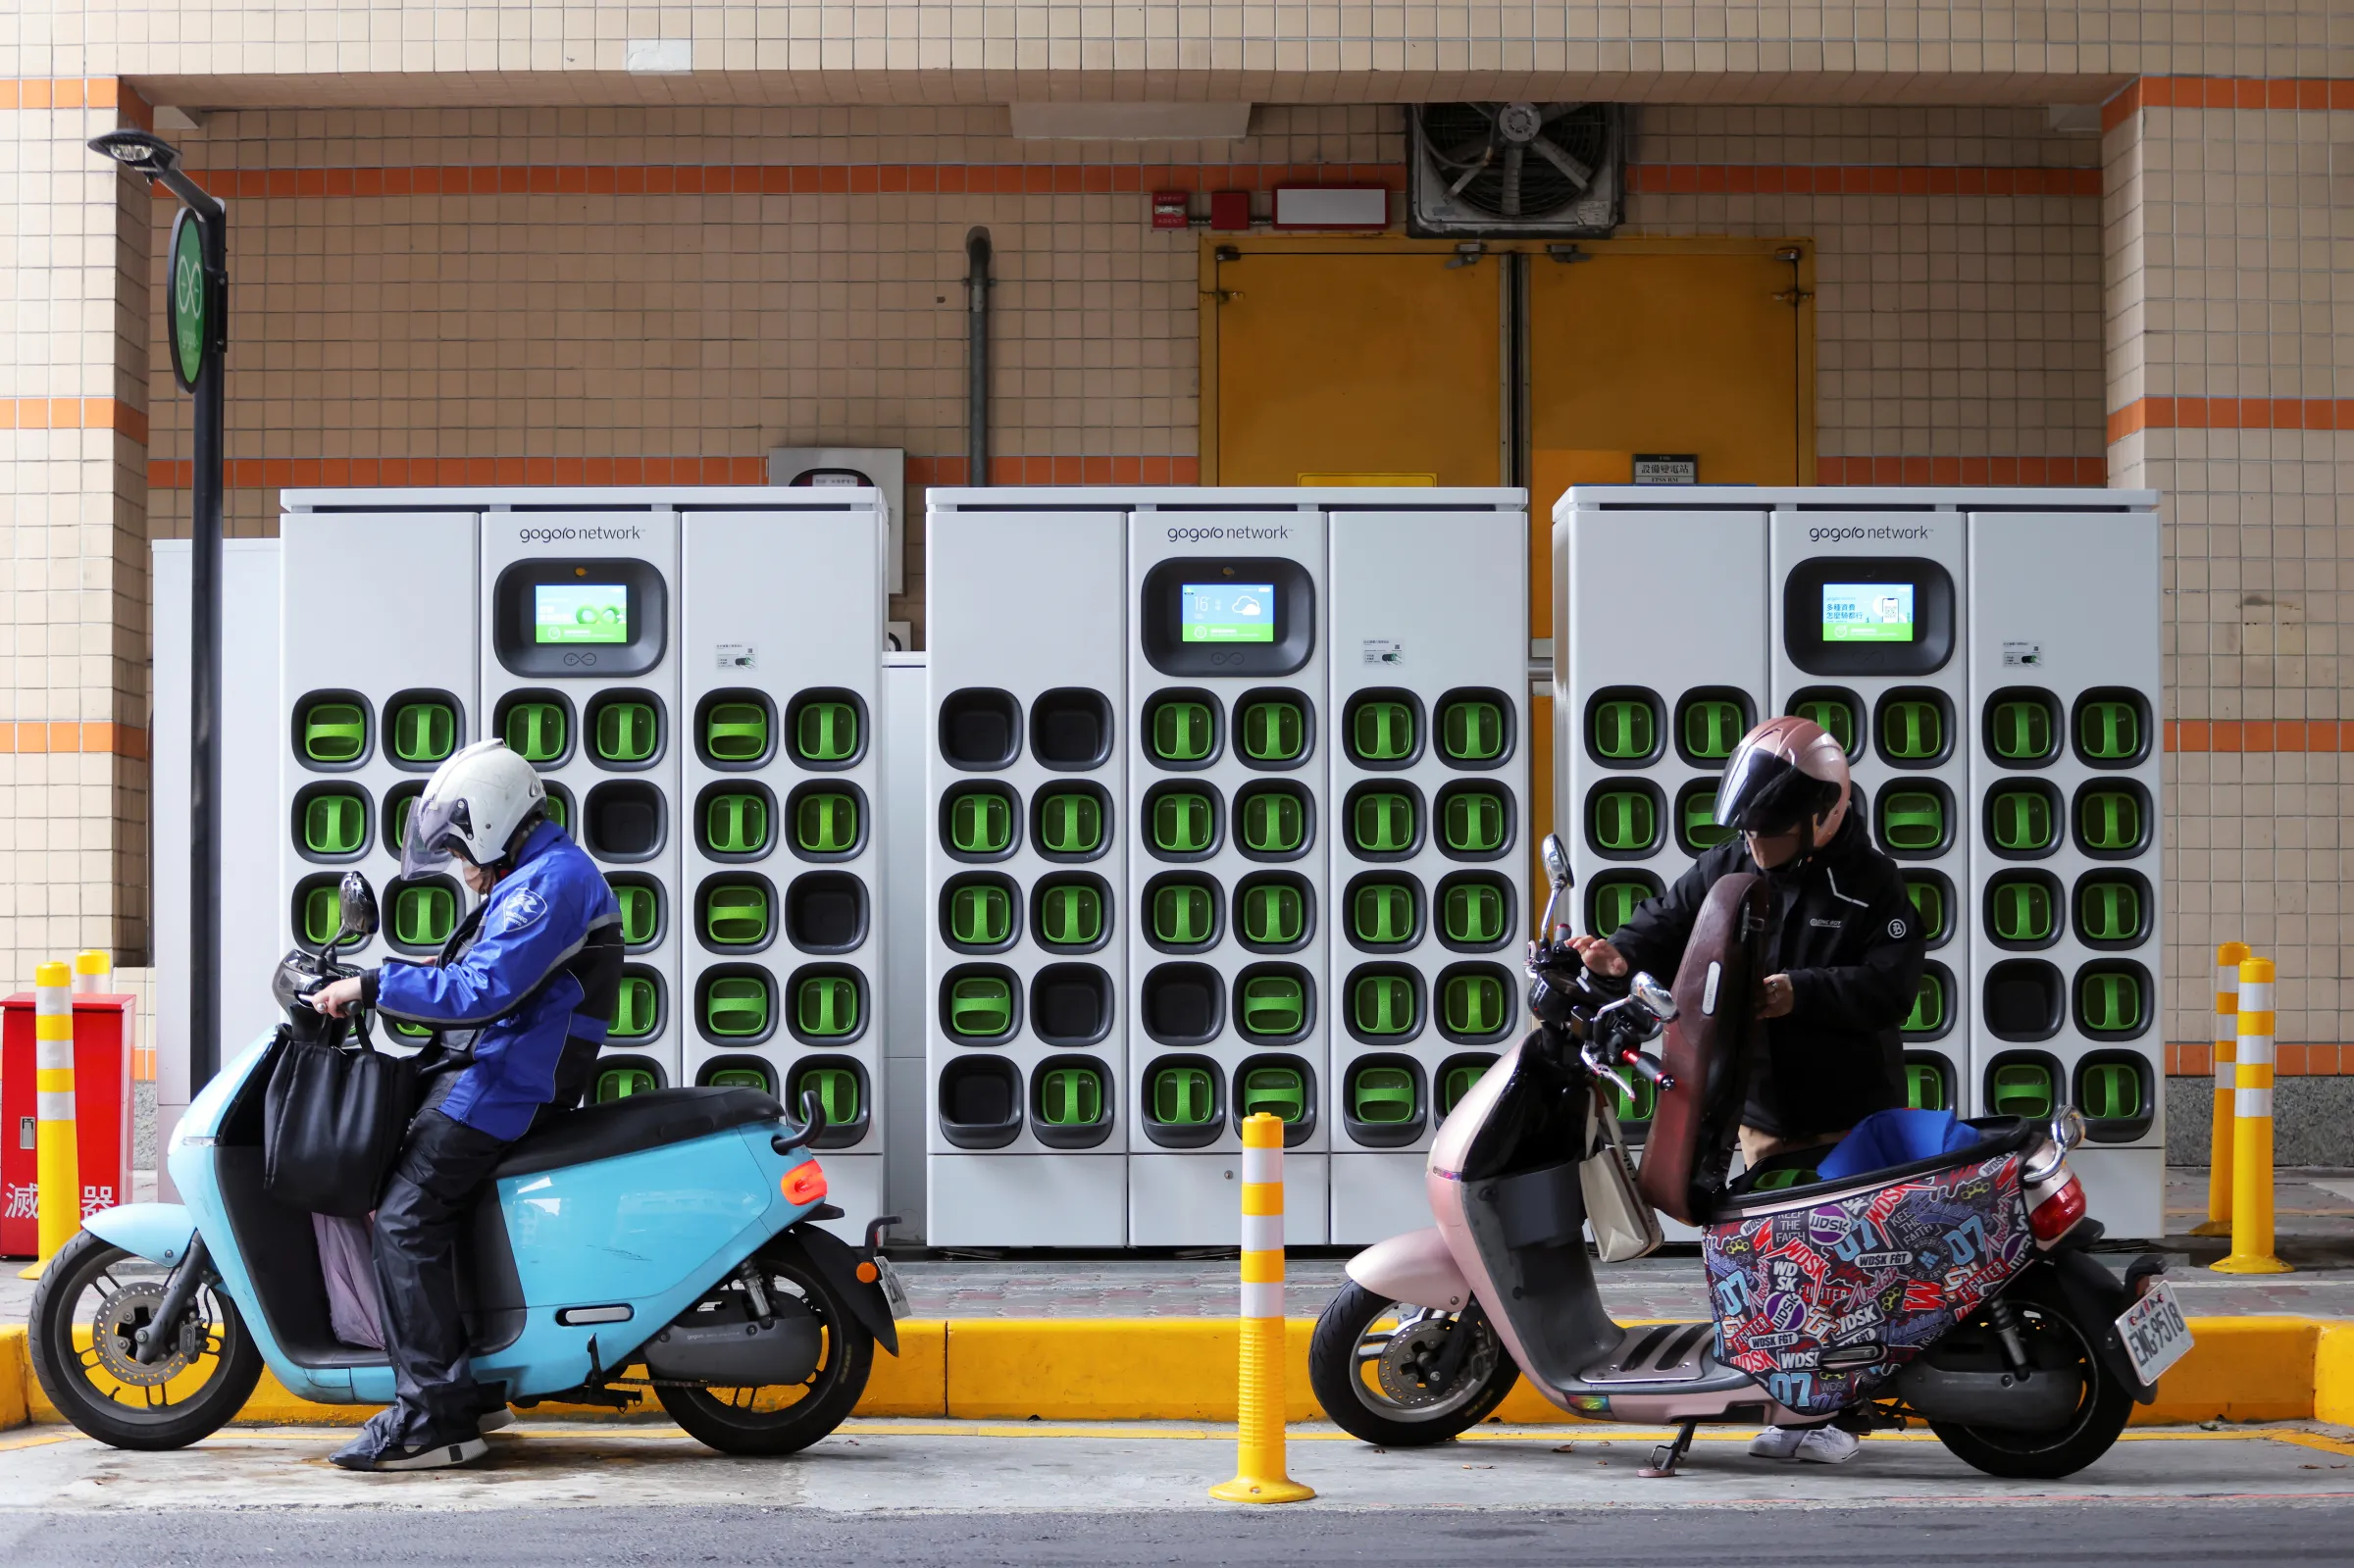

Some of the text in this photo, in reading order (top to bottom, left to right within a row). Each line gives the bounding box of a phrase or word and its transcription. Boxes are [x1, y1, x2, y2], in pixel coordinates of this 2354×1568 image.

[520, 527, 576, 543] gogoro
[1167, 527, 1223, 542] gogoro
[1809, 527, 1865, 542] gogoro
[1780, 1220, 1802, 1231] THE
[1890, 1208, 1912, 1227] KEE
[1942, 1215, 1985, 1266] 07
[1773, 1260, 1798, 1276] WD
[1776, 1277, 1799, 1291] SK
[1716, 1270, 1750, 1316] 07
[1772, 1293, 1799, 1330] WDSK
[1769, 1373, 1812, 1407] 07
[1820, 1381, 1849, 1392] WDSK
